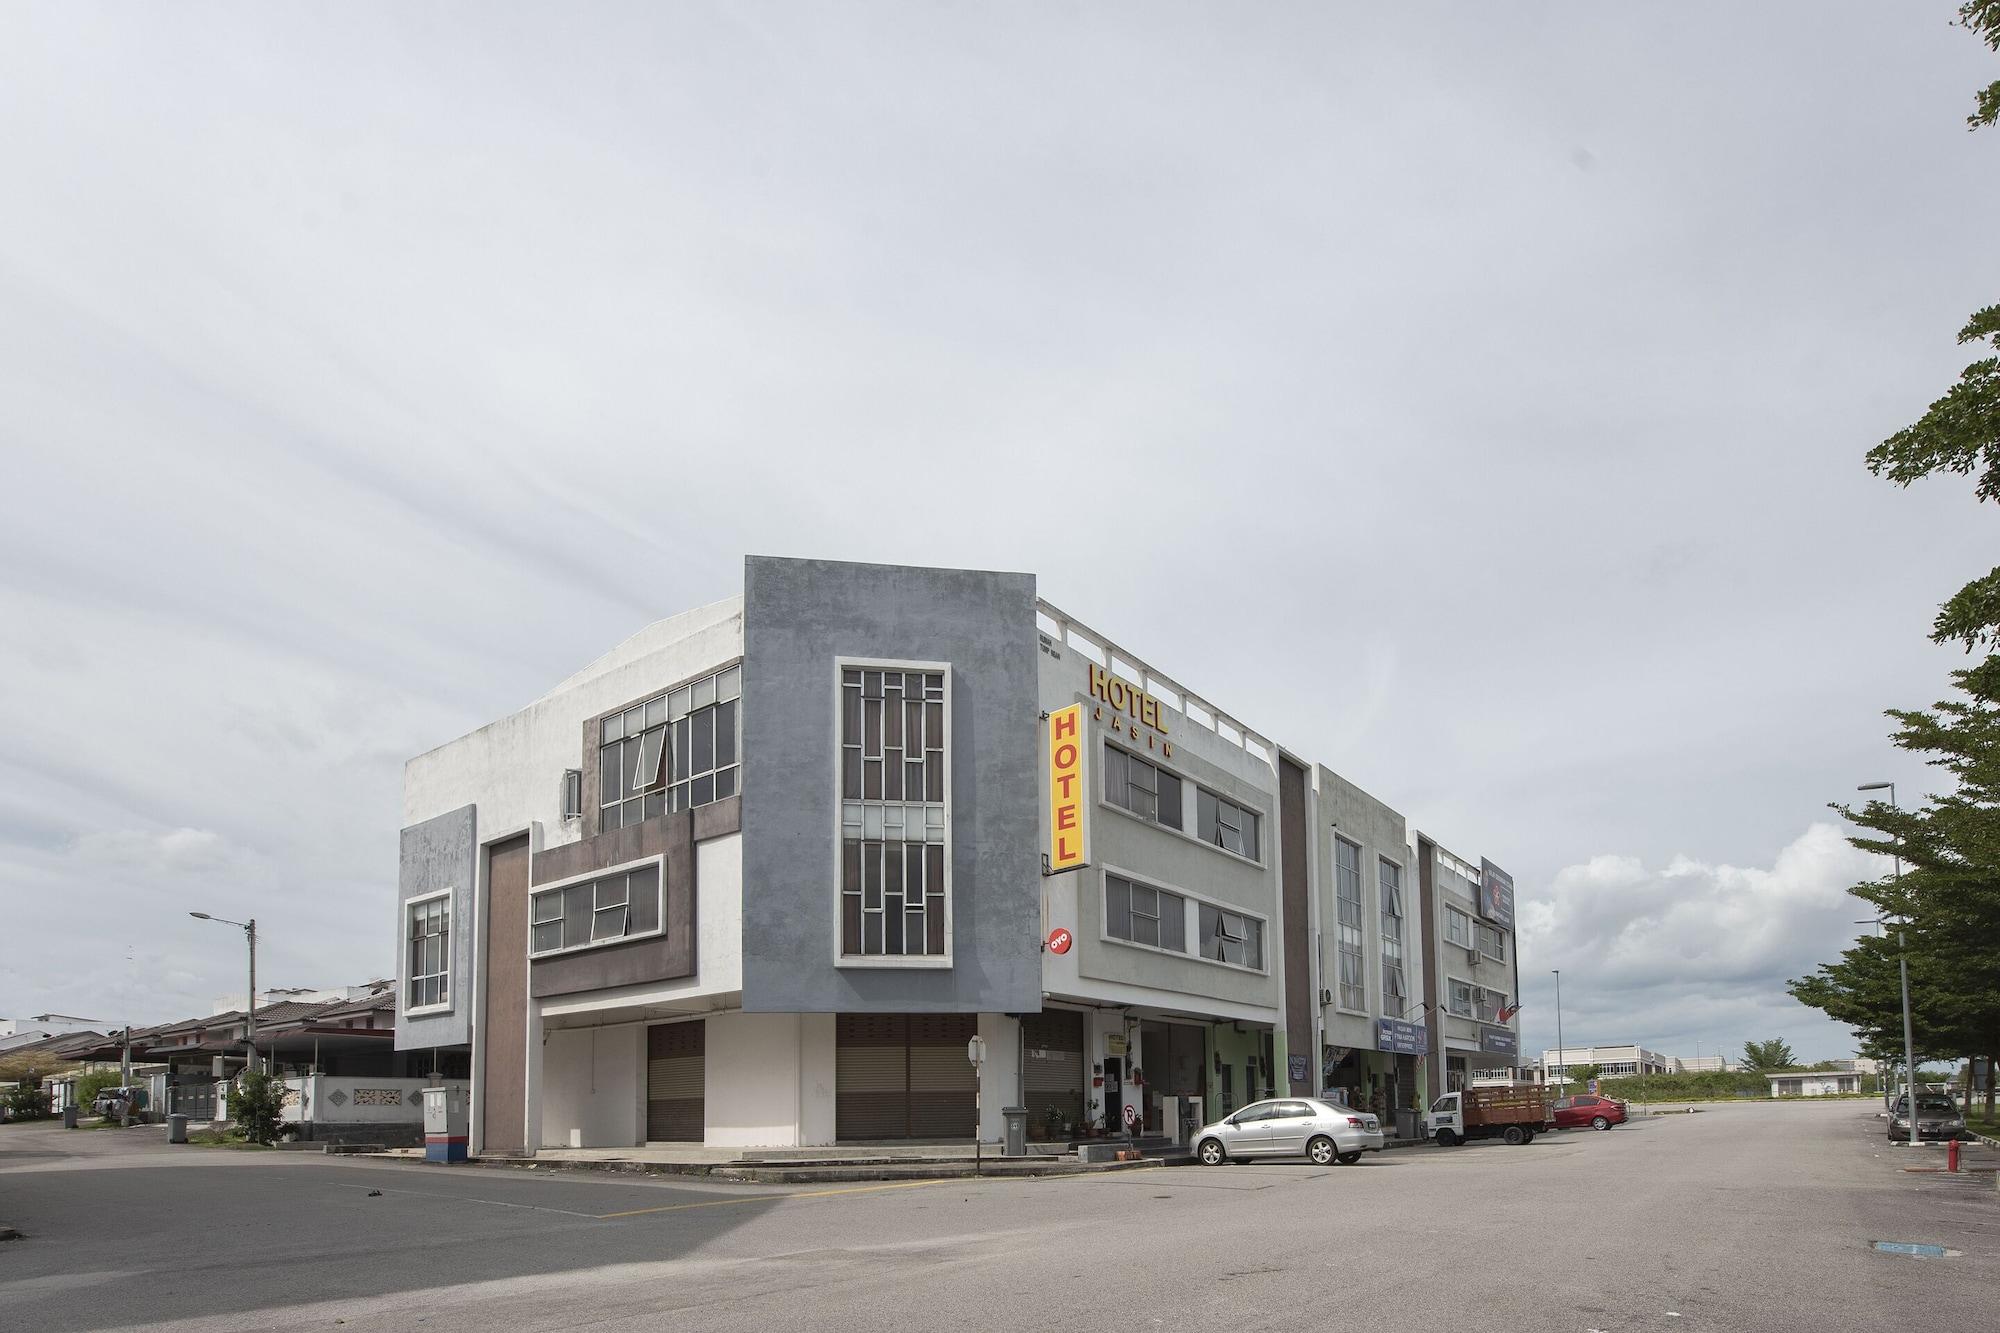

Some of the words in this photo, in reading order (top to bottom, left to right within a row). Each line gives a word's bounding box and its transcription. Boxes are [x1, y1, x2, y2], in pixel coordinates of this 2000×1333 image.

[1089, 663, 1169, 734] HOTEL
[1094, 707, 1173, 758] JASIN
[1055, 712, 1077, 861] HOTEL
[1051, 934, 1067, 948] OYO
